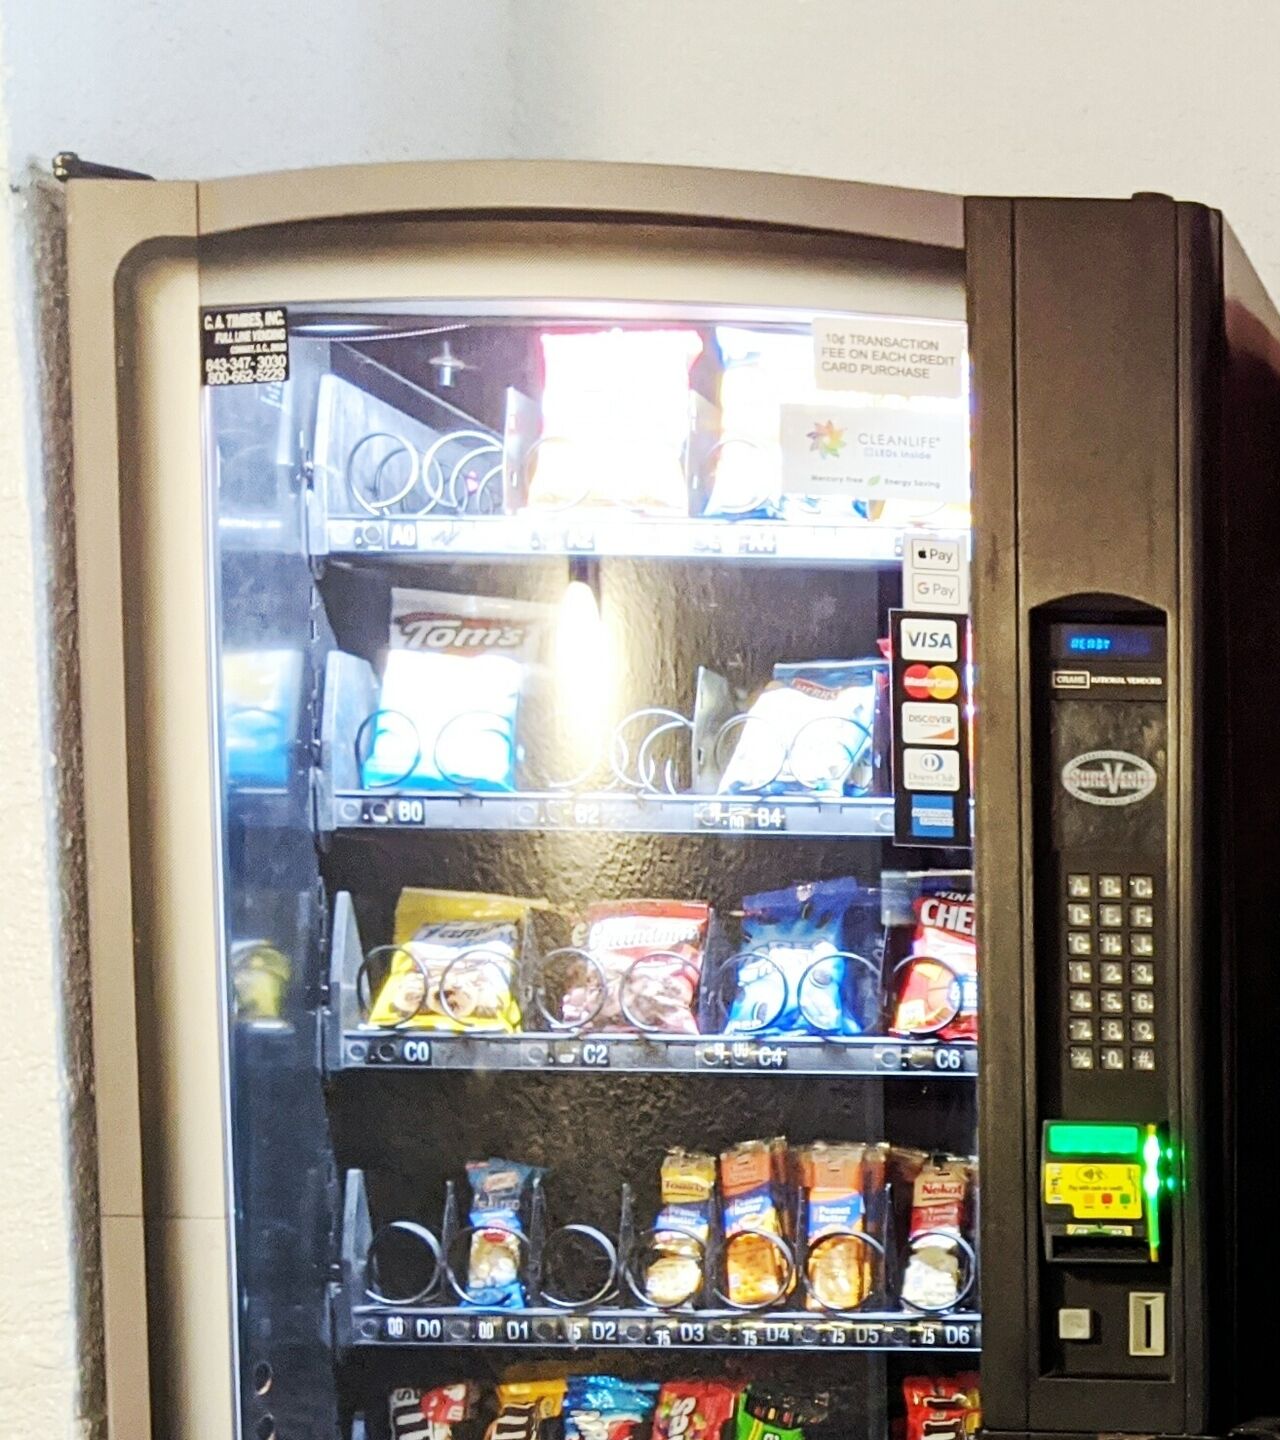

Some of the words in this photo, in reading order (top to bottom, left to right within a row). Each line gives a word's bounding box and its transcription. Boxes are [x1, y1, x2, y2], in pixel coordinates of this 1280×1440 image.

[850, 333, 940, 352] TRANSACTION
[821, 347, 847, 359] FEE
[850, 348, 870, 360] ON
[871, 351, 907, 363] EACH
[909, 353, 957, 367] CREDIT
[821, 361, 858, 374] CARD
[860, 364, 931, 380] PURCHASE
[929, 547, 953, 564] Pay
[402, 618, 525, 649] Tom's
[907, 630, 953, 650] VISA
[1106, 966, 1117, 981] 2
[1137, 965, 1148, 981] 3
[1137, 995, 1148, 1010] 6
[1107, 1022, 1119, 1039] 8
[403, 1041, 430, 1062] C0
[582, 1042, 608, 1063] C2
[935, 1047, 961, 1069] C6
[416, 1319, 441, 1339] D0
[506, 1320, 528, 1340] D1
[592, 1321, 617, 1341] D2
[680, 1322, 705, 1342] D3
[766, 1324, 790, 1343] D4
[856, 1324, 880, 1344] D5
[945, 1325, 970, 1345] D6
